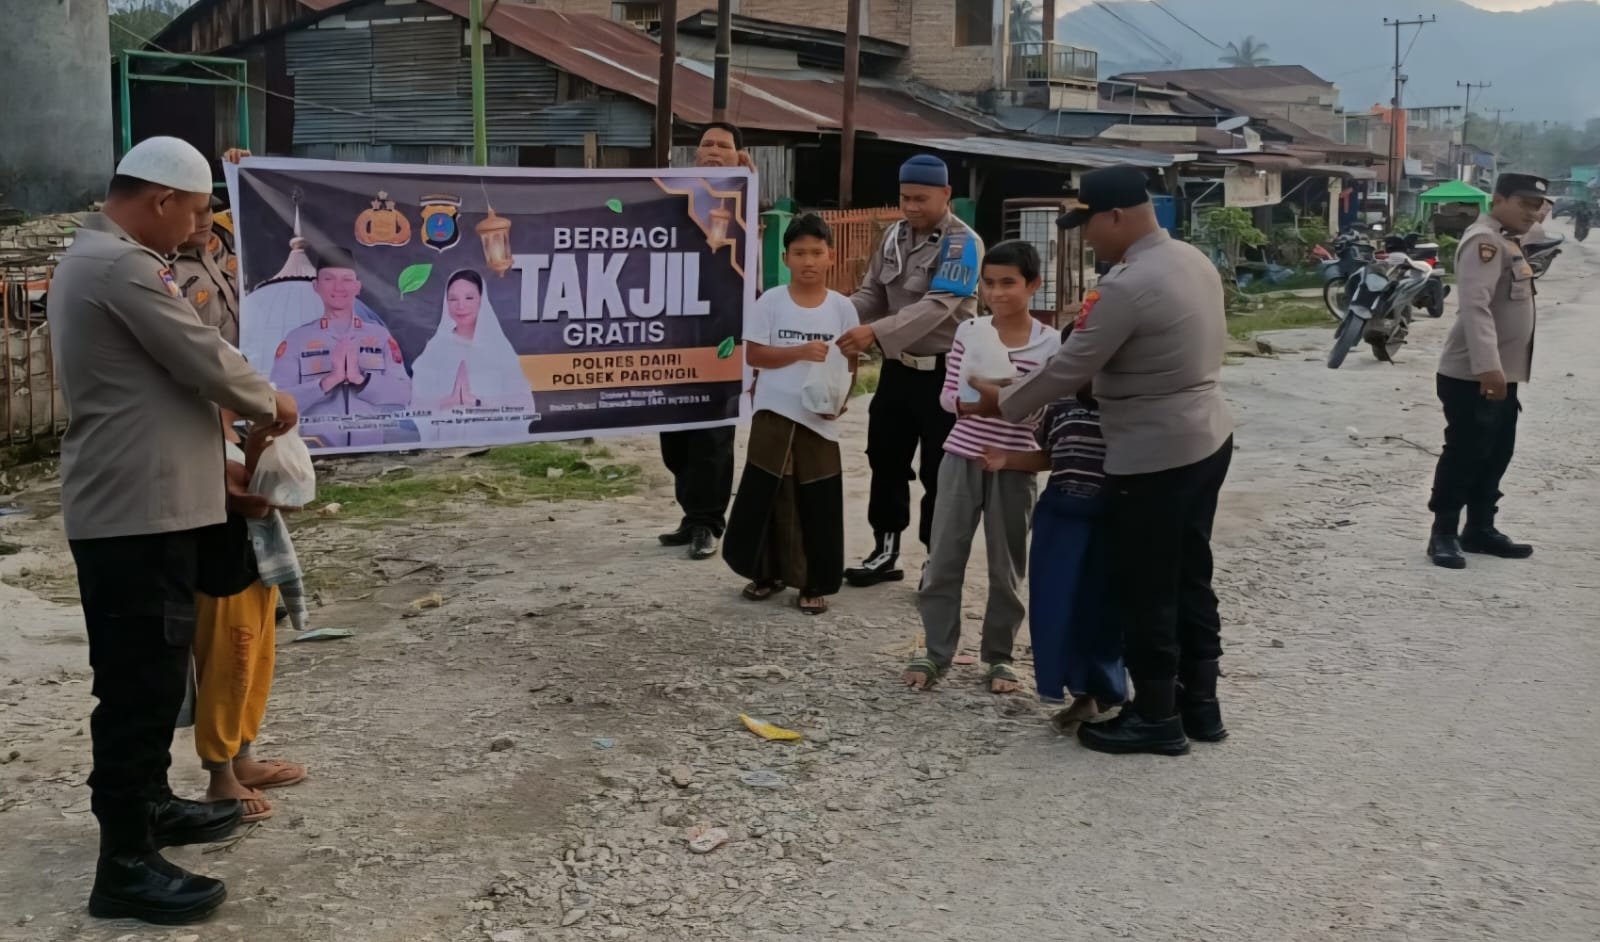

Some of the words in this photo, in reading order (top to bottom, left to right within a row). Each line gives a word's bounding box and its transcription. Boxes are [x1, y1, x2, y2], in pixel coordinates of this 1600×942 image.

[553, 226, 678, 249] BERBAGI
[511, 251, 711, 321] TAKJIL
[562, 321, 665, 346] GRATIS
[572, 355, 634, 369] POLRES
[640, 353, 681, 366] DAIRI
[552, 371, 614, 385] POLSEK
